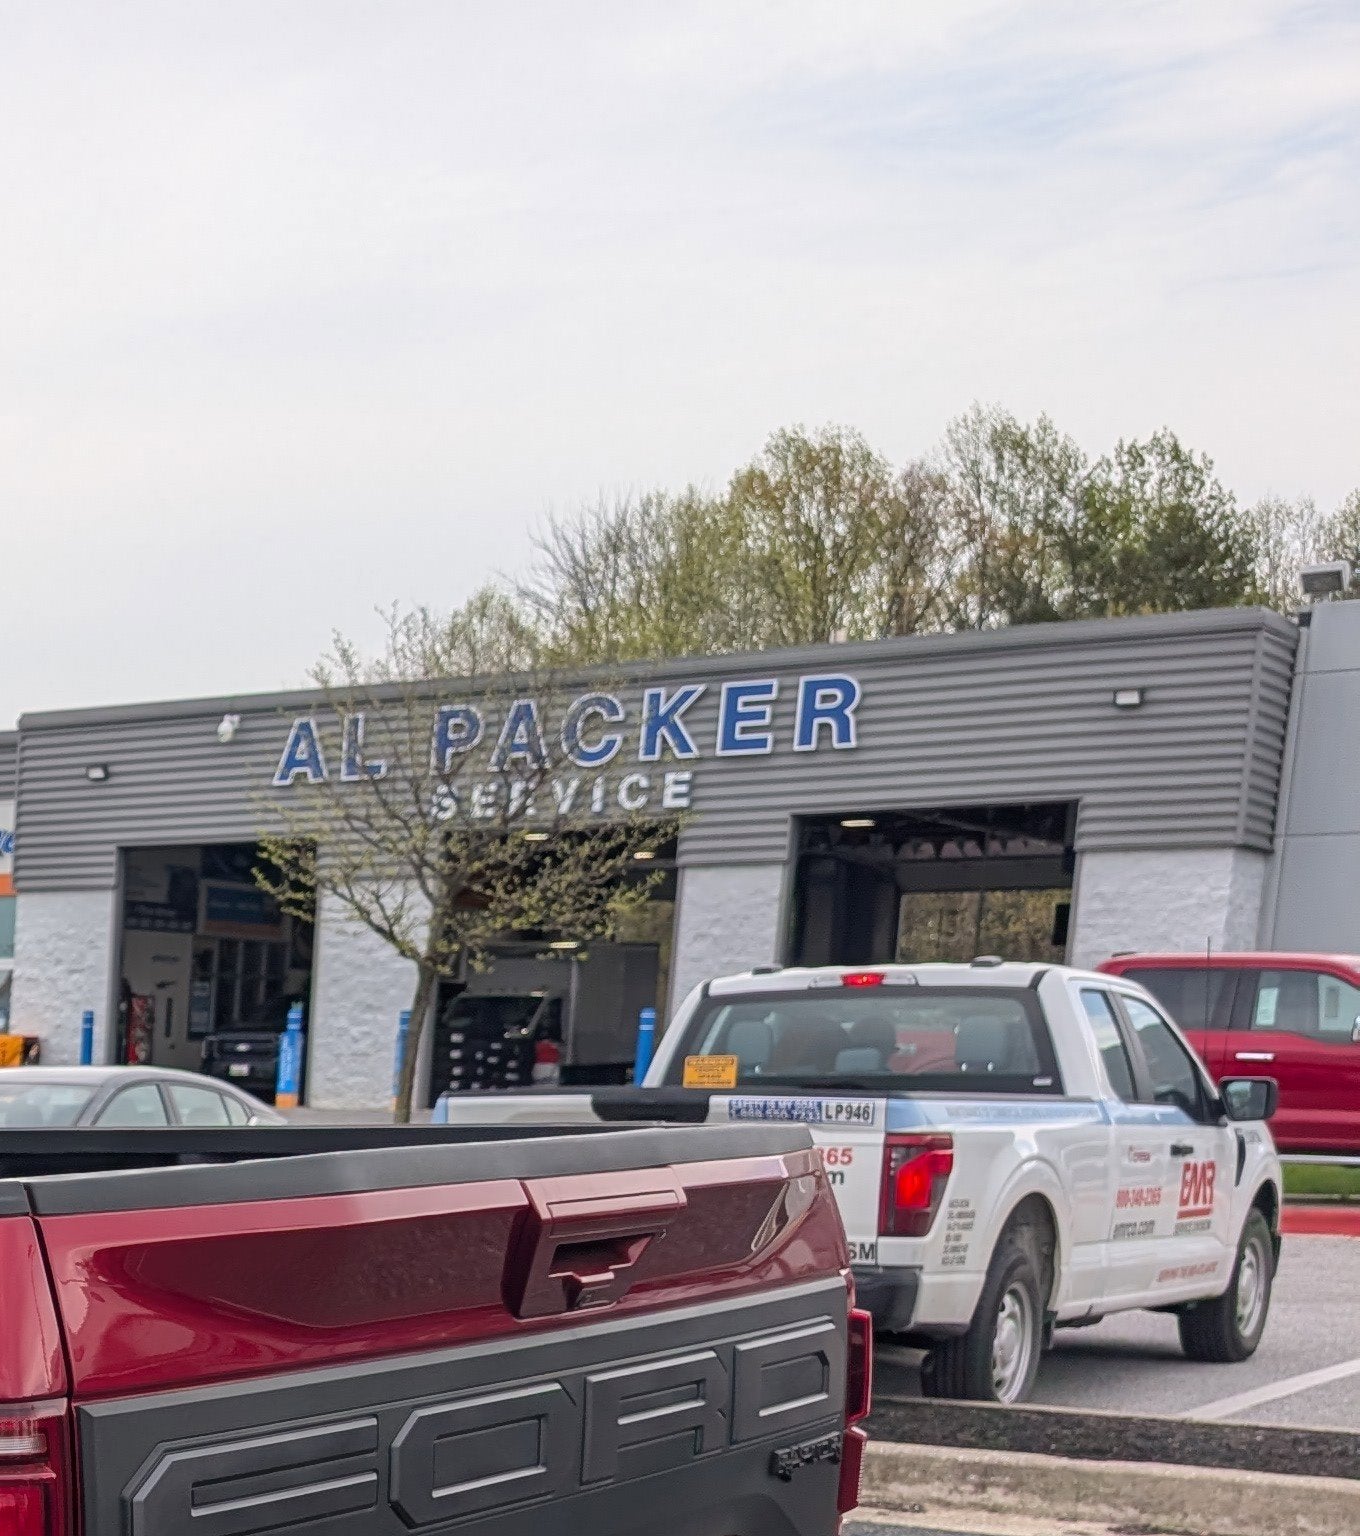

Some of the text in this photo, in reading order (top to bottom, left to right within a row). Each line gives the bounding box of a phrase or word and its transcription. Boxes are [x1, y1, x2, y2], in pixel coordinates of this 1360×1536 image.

[272, 672, 863, 787] AL PACKER
[430, 770, 693, 821] SERVICE
[824, 1103, 871, 1121] LP946
